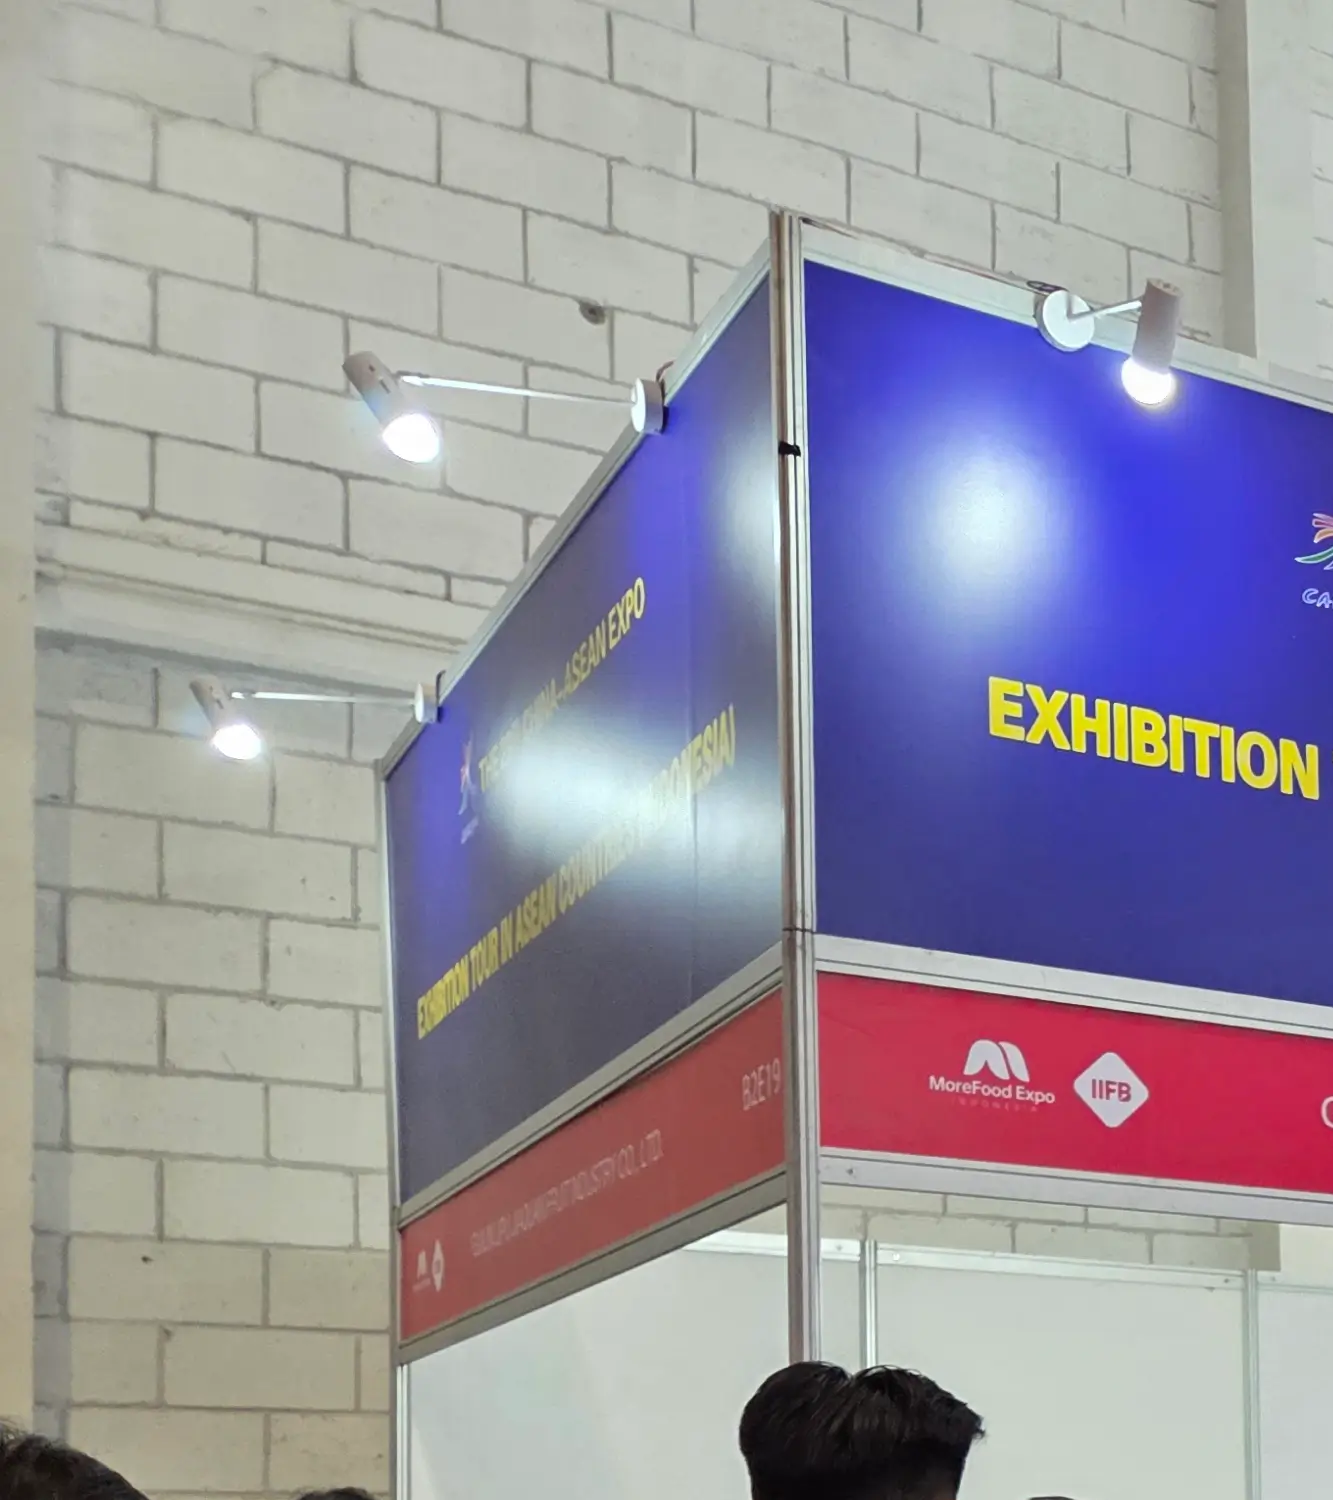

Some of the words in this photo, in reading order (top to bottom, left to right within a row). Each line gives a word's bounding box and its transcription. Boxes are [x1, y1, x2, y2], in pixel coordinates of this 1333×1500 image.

[609, 577, 645, 650] EXPO
[988, 676, 1320, 801] EXHIBITION
[742, 1058, 781, 1111] B2E19
[929, 1075, 1012, 1099] MoreFood
[1015, 1086, 1056, 1106] Expo
[1092, 1079, 1132, 1103] IIFB
